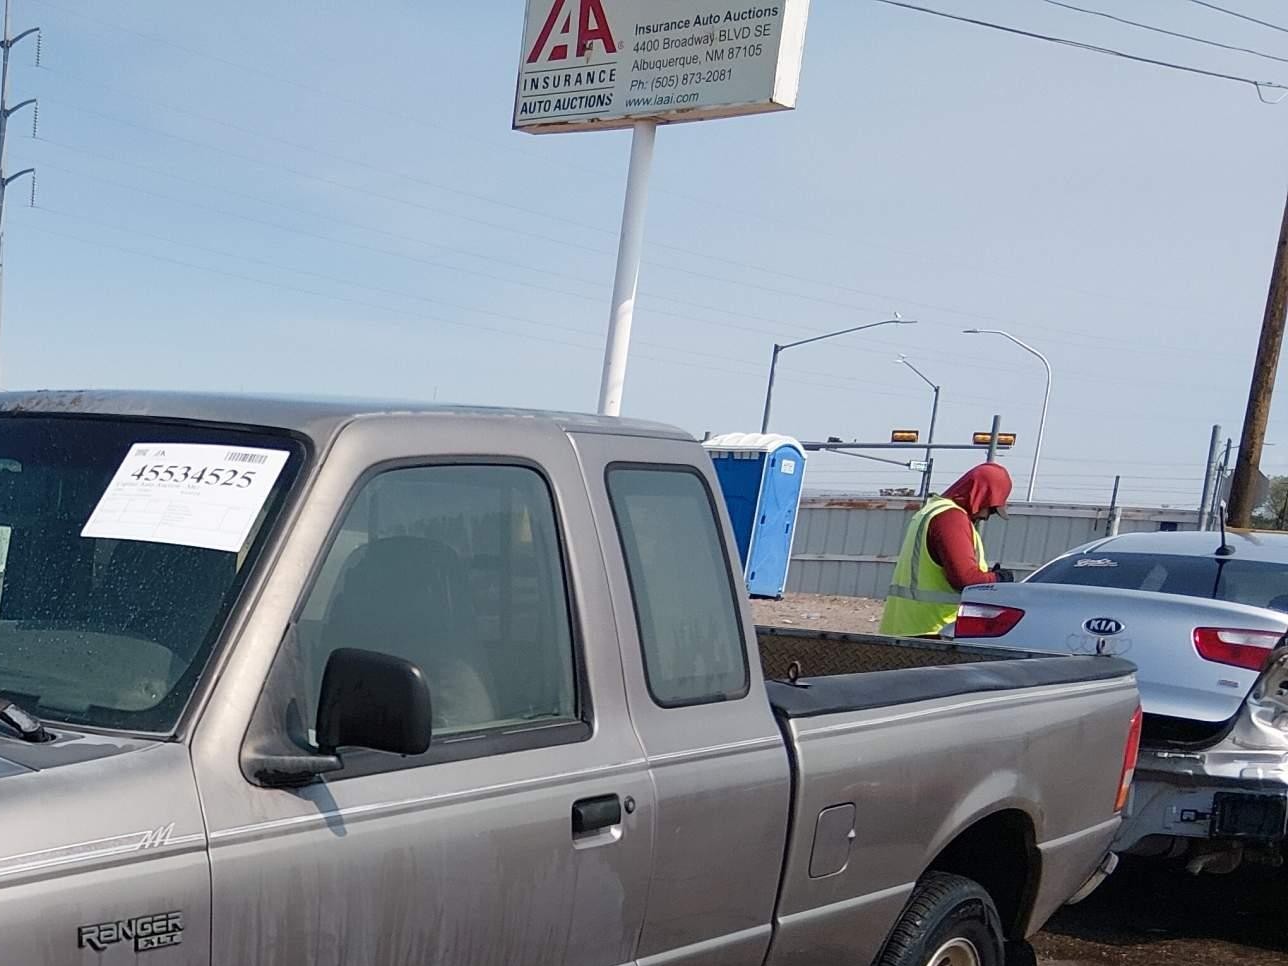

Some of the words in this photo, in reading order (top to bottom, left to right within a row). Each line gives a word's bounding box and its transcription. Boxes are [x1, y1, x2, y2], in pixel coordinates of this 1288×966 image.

[634, 19, 690, 36] Insurance
[693, 13, 721, 28] Auto
[723, 6, 779, 23] Auctions
[633, 38, 660, 53] 4400
[662, 32, 715, 51] Broadway
[718, 27, 751, 43] BLVD
[754, 23, 772, 38] SE
[631, 50, 702, 73] Albuquerque,
[705, 48, 725, 62] NM
[727, 44, 763, 60] 87105
[523, 68, 617, 92] INSURANCE
[630, 78, 648, 92] Ph:
[650, 73, 680, 92] (505)
[681, 68, 733, 86] 873-2081
[520, 98, 552, 115] AUTO
[553, 92, 614, 111] AUCTIONS
[625, 91, 699, 108] www.iaai.com
[131, 463, 257, 489] 45534525
[1089, 618, 1116, 633] KIA
[78, 911, 185, 951] RANGER
